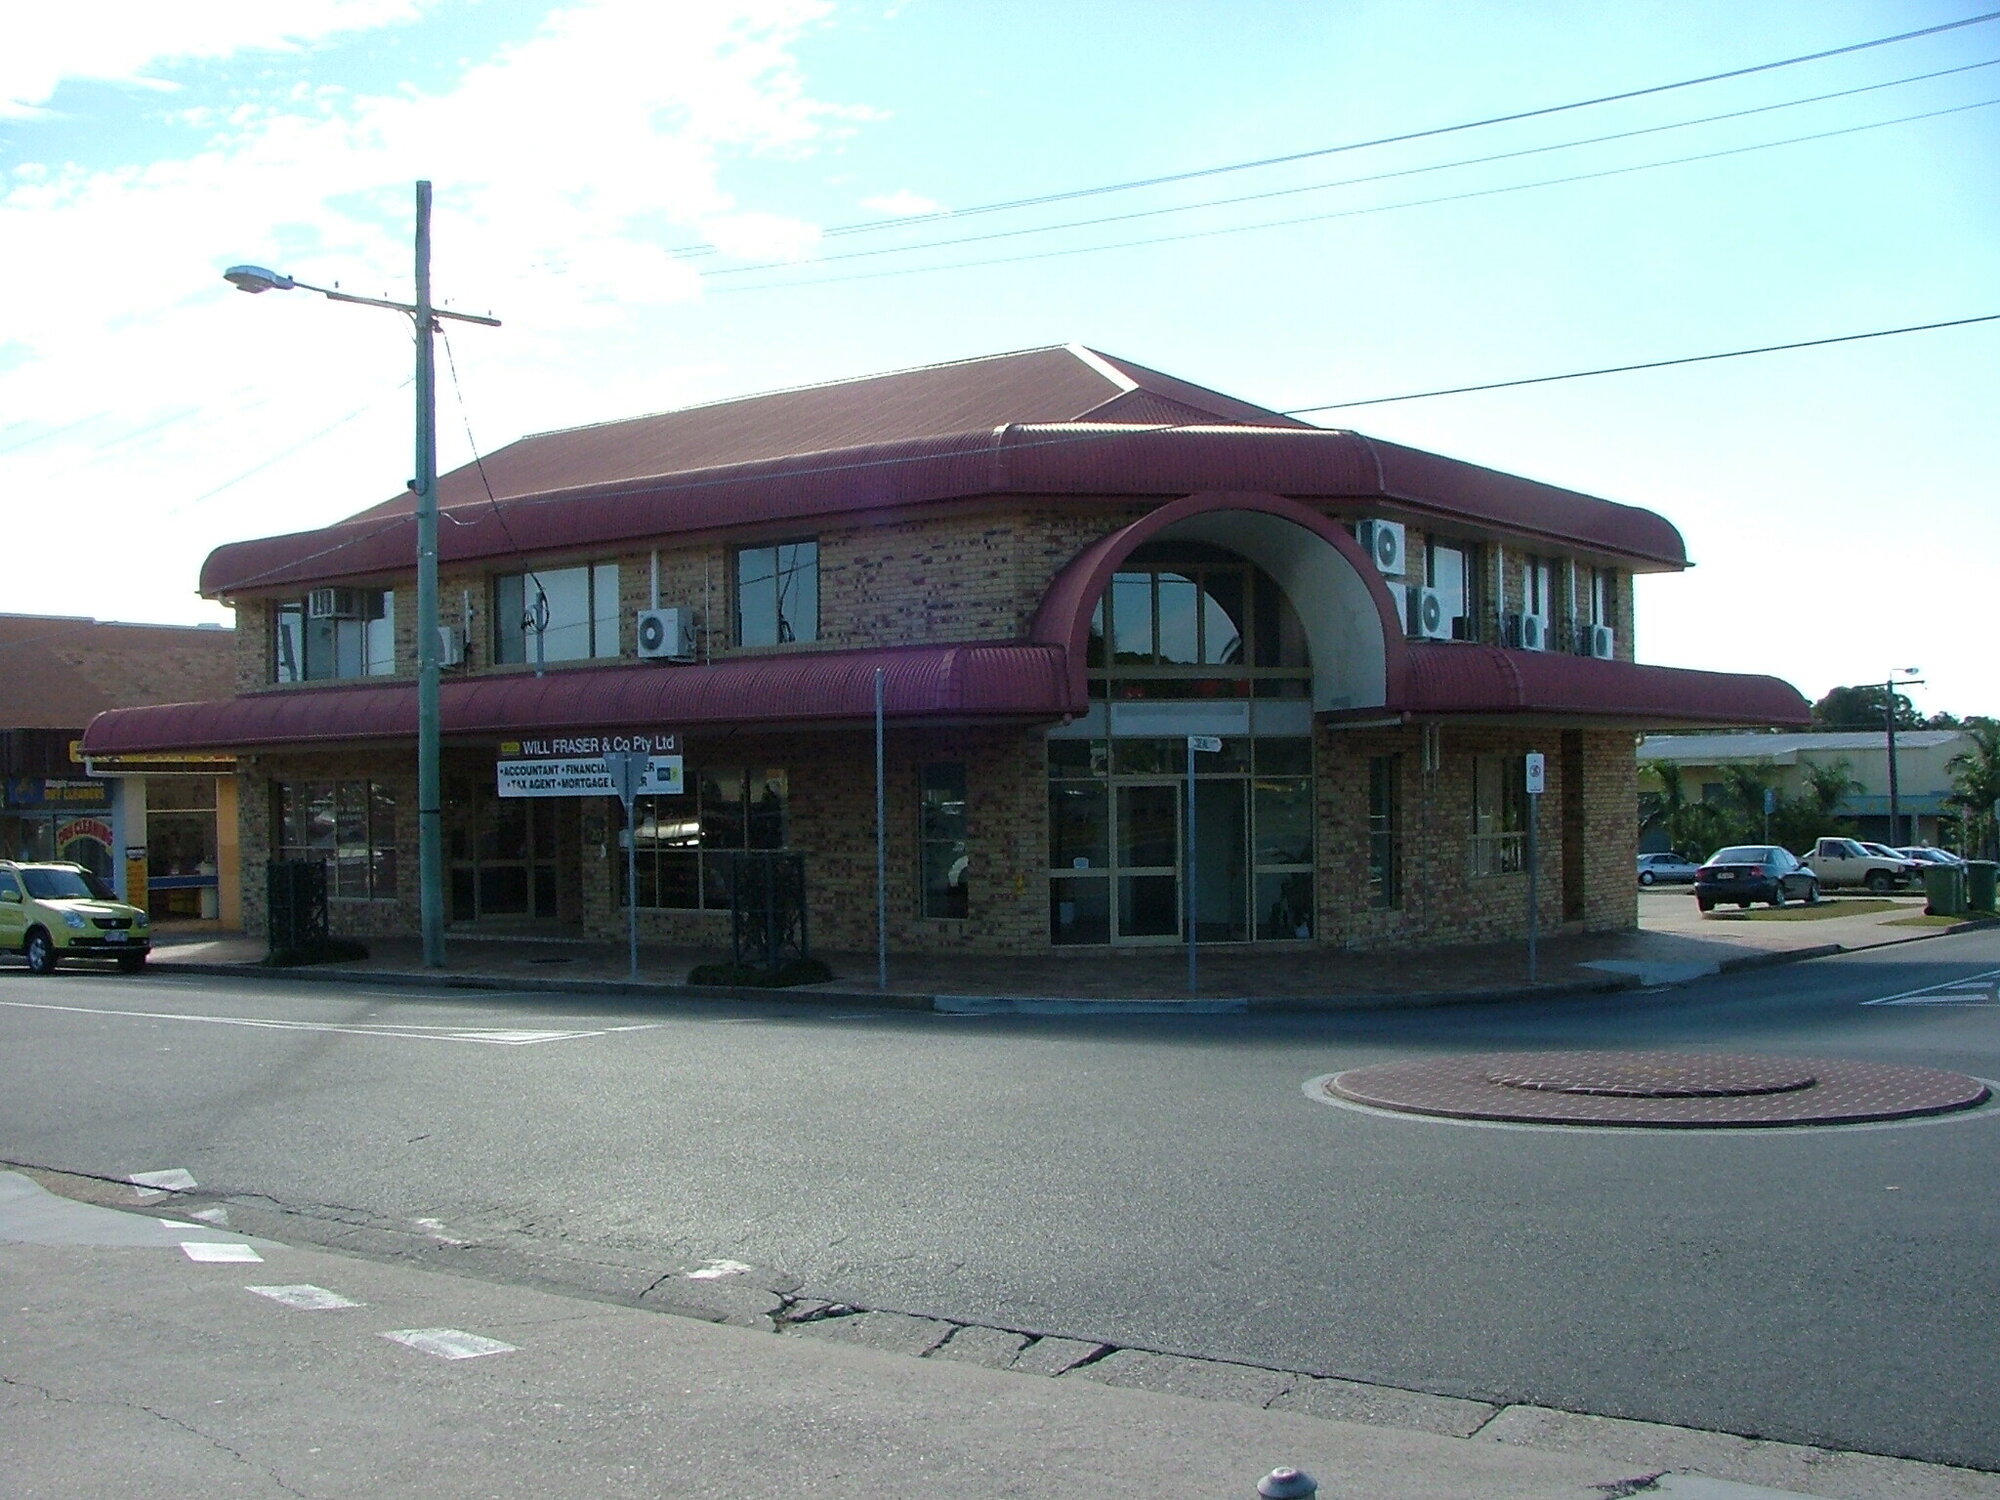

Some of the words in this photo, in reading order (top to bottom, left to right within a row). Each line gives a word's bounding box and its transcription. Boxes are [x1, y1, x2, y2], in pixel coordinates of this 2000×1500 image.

[522, 741, 550, 755] WILL
[553, 738, 599, 753] FRASER
[602, 737, 611, 752] &
[613, 736, 629, 751] Co
[632, 735, 650, 752] Pty
[654, 735, 674, 751] Ltd
[504, 765, 559, 776] ACCOUNTANT
[511, 780, 527, 790] TAX
[530, 779, 556, 789] AGENT
[561, 777, 609, 789] MORTGAGE
